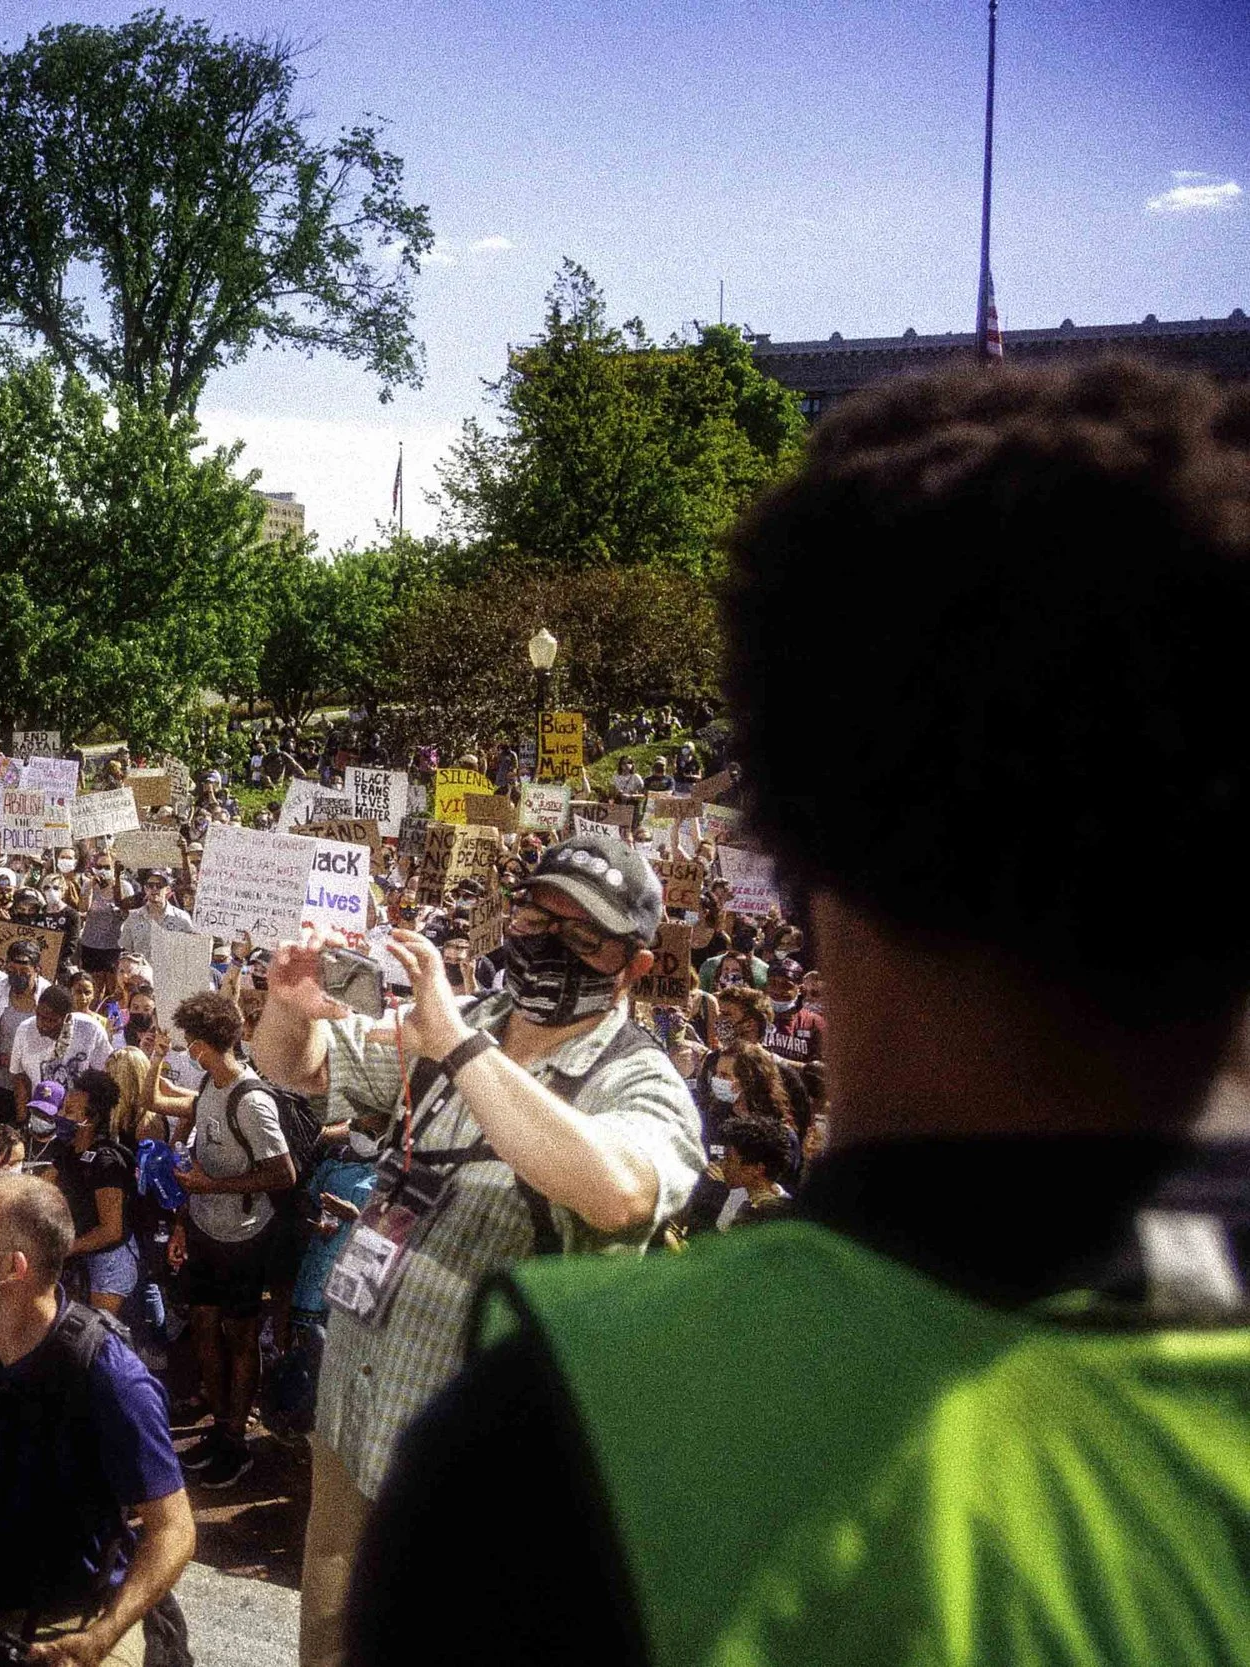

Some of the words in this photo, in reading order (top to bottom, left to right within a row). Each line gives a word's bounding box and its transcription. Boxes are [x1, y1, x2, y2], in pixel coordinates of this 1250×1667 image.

[541, 713, 578, 734] Black
[23, 732, 48, 742] END
[541, 735, 578, 754] Lives
[354, 770, 392, 786] BLACK
[354, 783, 390, 798] TRANS
[354, 795, 391, 810] LIVES
[354, 806, 391, 823] MATTER
[3, 828, 43, 849] POLICE
[430, 830, 455, 849] NO
